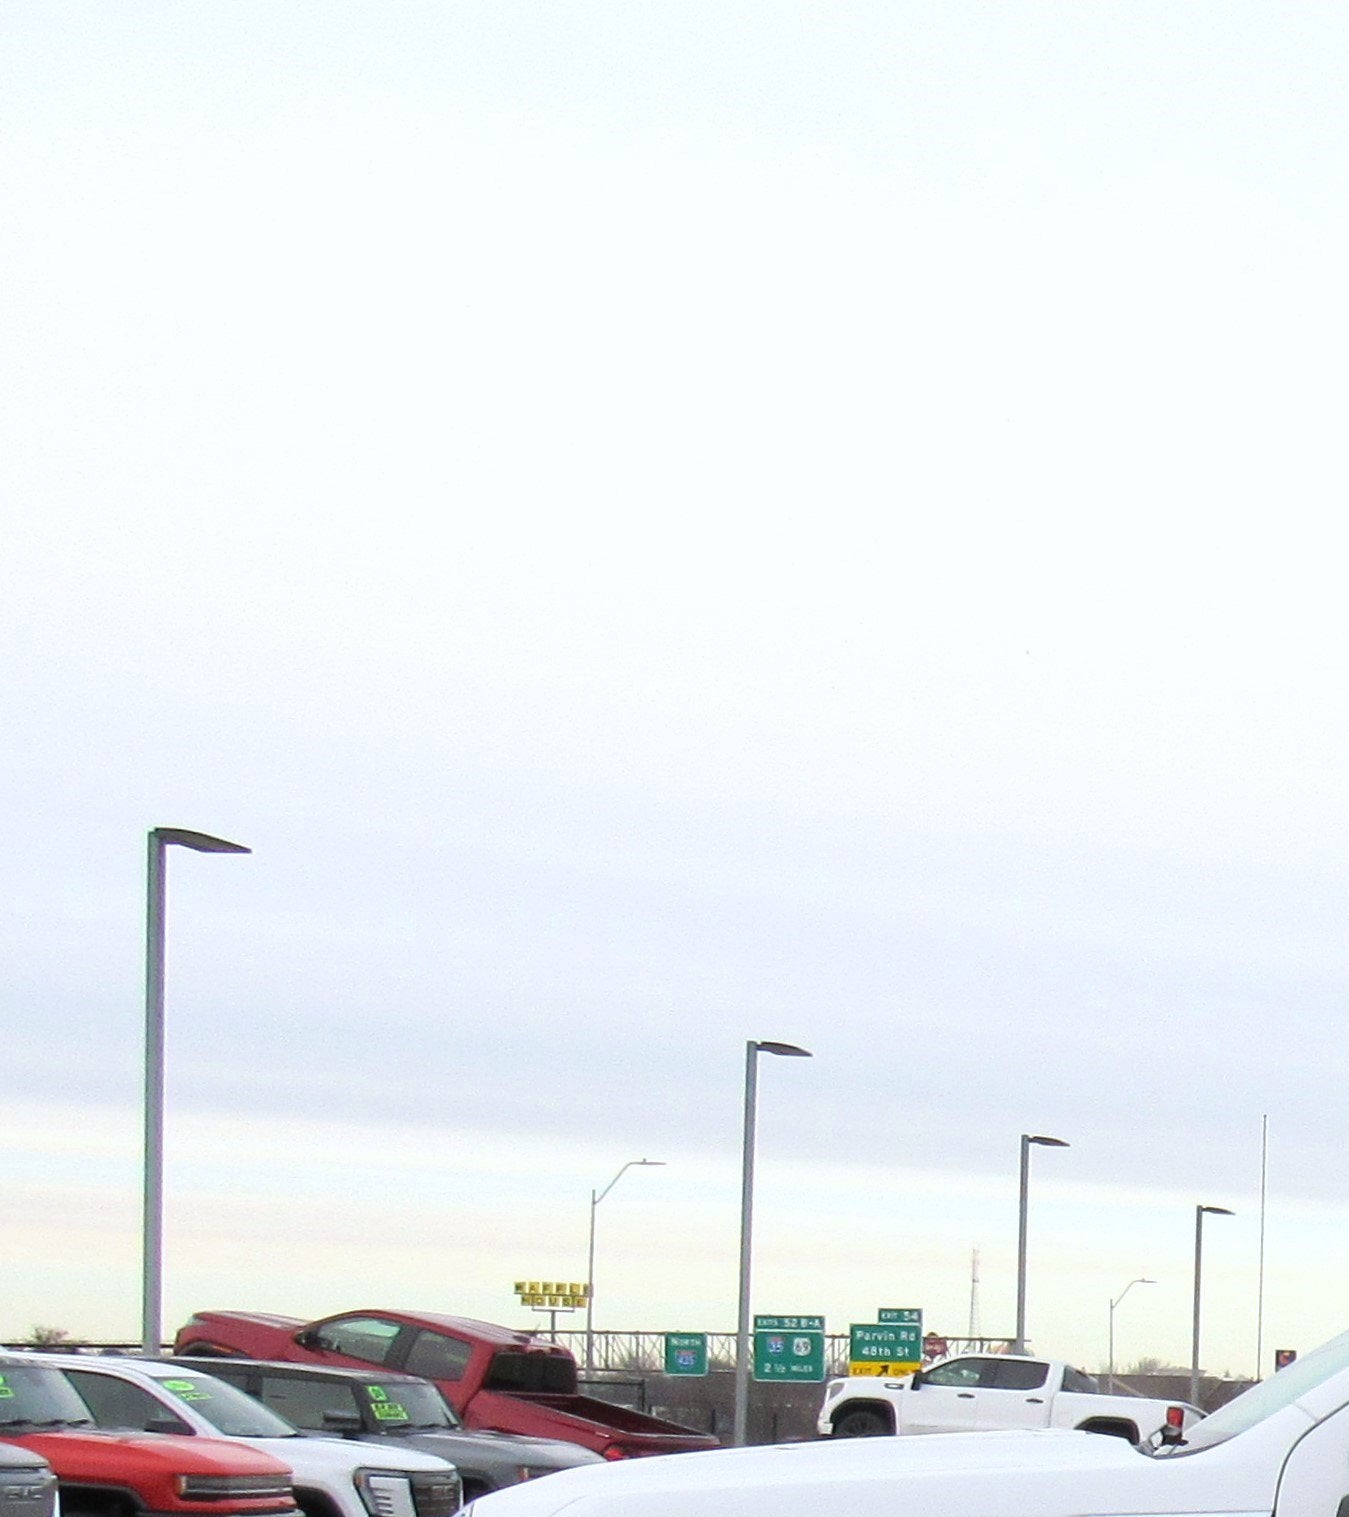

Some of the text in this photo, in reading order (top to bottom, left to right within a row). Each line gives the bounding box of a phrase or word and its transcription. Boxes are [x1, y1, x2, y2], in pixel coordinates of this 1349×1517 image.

[903, 1311, 919, 1321] 54
[783, 1318, 797, 1328] 52
[856, 1330, 916, 1341] Parvin Rd
[862, 1346, 909, 1357] 48th St
